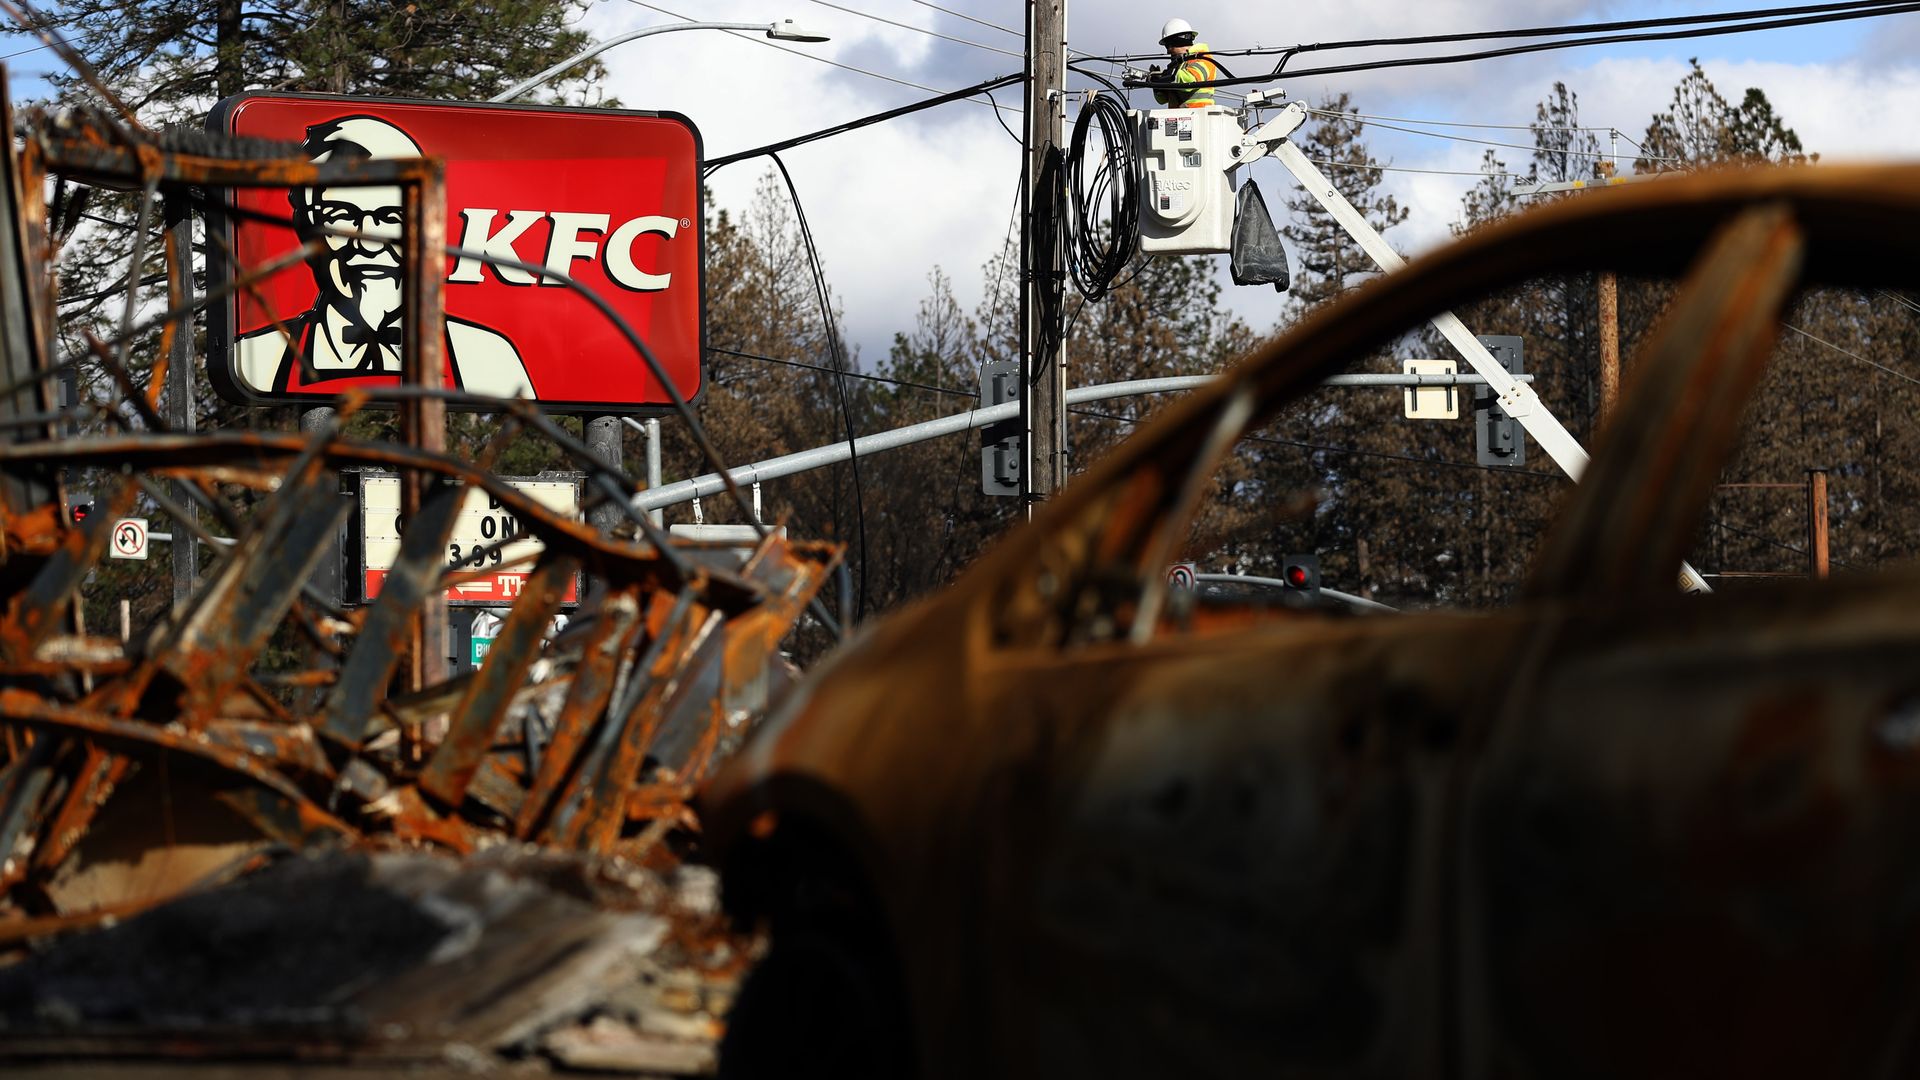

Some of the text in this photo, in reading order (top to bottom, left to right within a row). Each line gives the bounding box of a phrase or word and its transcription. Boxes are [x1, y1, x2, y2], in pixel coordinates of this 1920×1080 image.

[447, 208, 680, 292] KFC
[497, 575, 527, 597] Th
[475, 642, 491, 658] Bill
